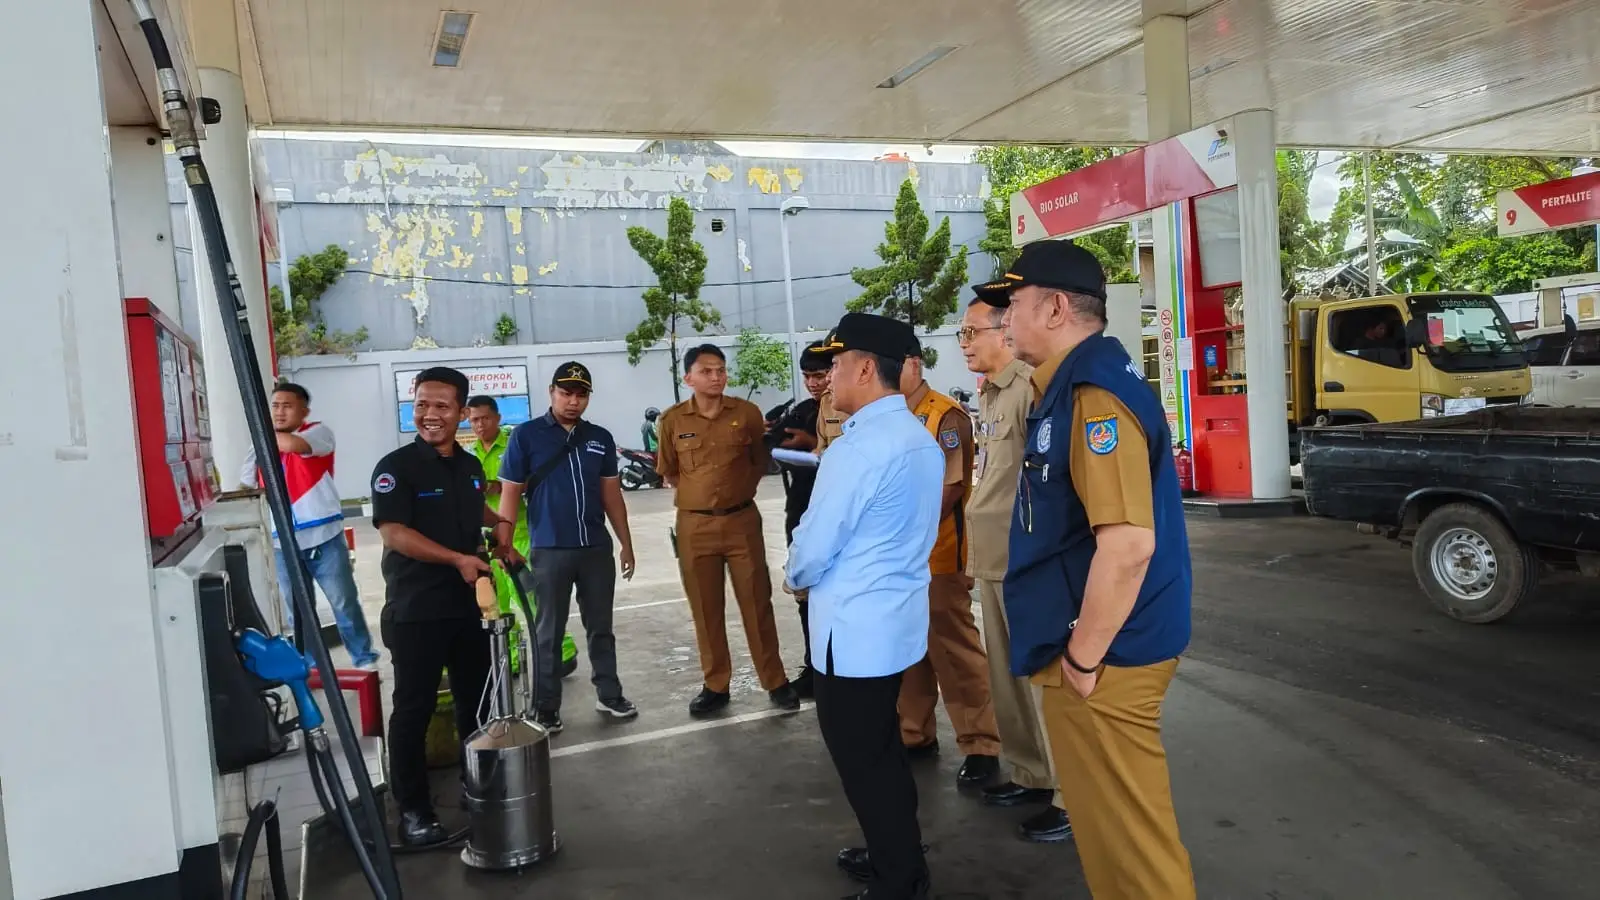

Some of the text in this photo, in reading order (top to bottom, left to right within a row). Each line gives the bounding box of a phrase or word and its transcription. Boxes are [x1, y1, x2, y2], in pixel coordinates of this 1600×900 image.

[1039, 191, 1079, 214] BIO SOLAR
[1541, 190, 1592, 209] PERTALITE
[1017, 214, 1026, 235] 5
[1506, 209, 1517, 226] 9
